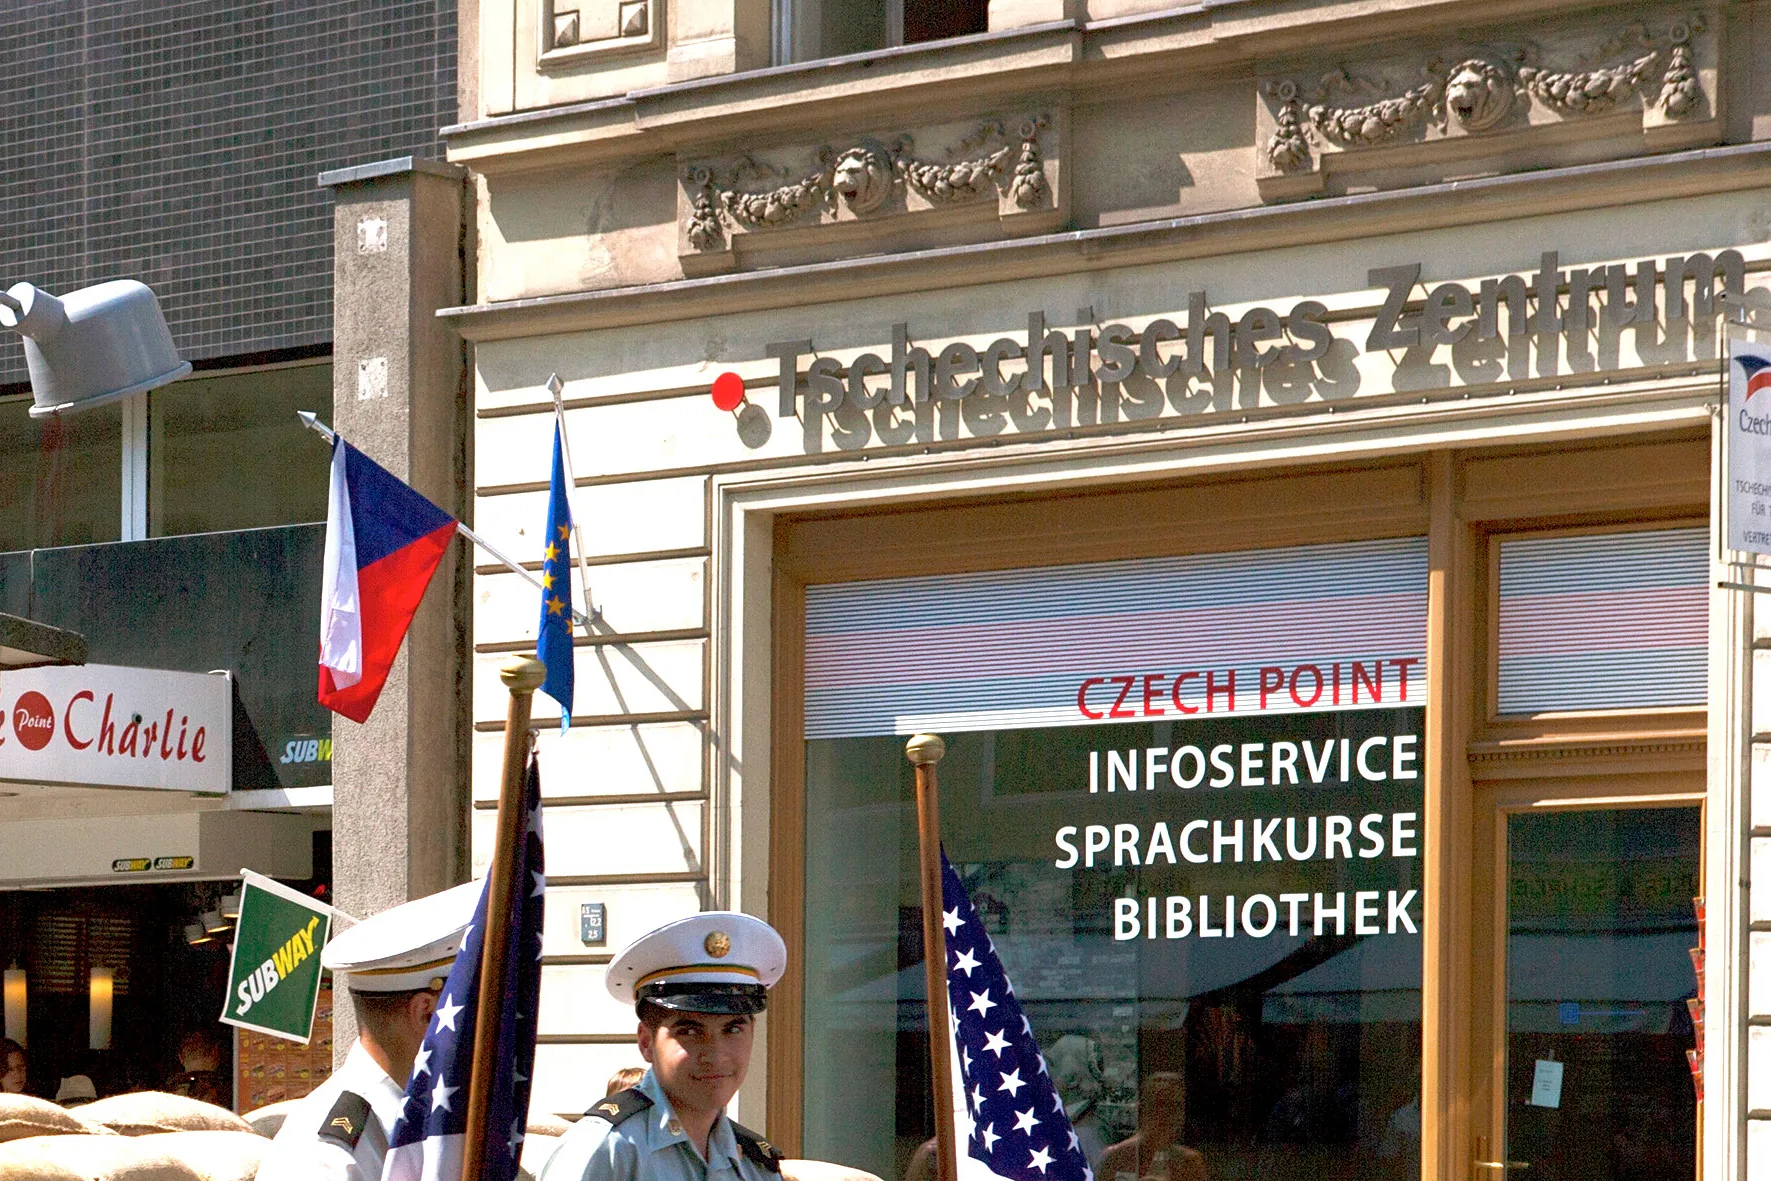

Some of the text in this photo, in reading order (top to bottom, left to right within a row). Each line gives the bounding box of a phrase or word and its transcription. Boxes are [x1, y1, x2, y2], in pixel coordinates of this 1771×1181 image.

[766, 249, 1745, 417] Tschechisches Zentrum
[1077, 657, 1419, 721] CZECH POINT
[16, 708, 53, 731] Point
[64, 690, 206, 763] Charlie
[280, 739, 332, 764] SUBW
[1089, 735, 1418, 794] INFOSERVICE
[113, 859, 150, 872] SUBWAY
[155, 857, 193, 870] SUBWAY
[1054, 812, 1418, 870] SPRACHKURSE
[1114, 889, 1419, 941] BIBLIOTHEK
[236, 915, 320, 1017] SUBWAY
